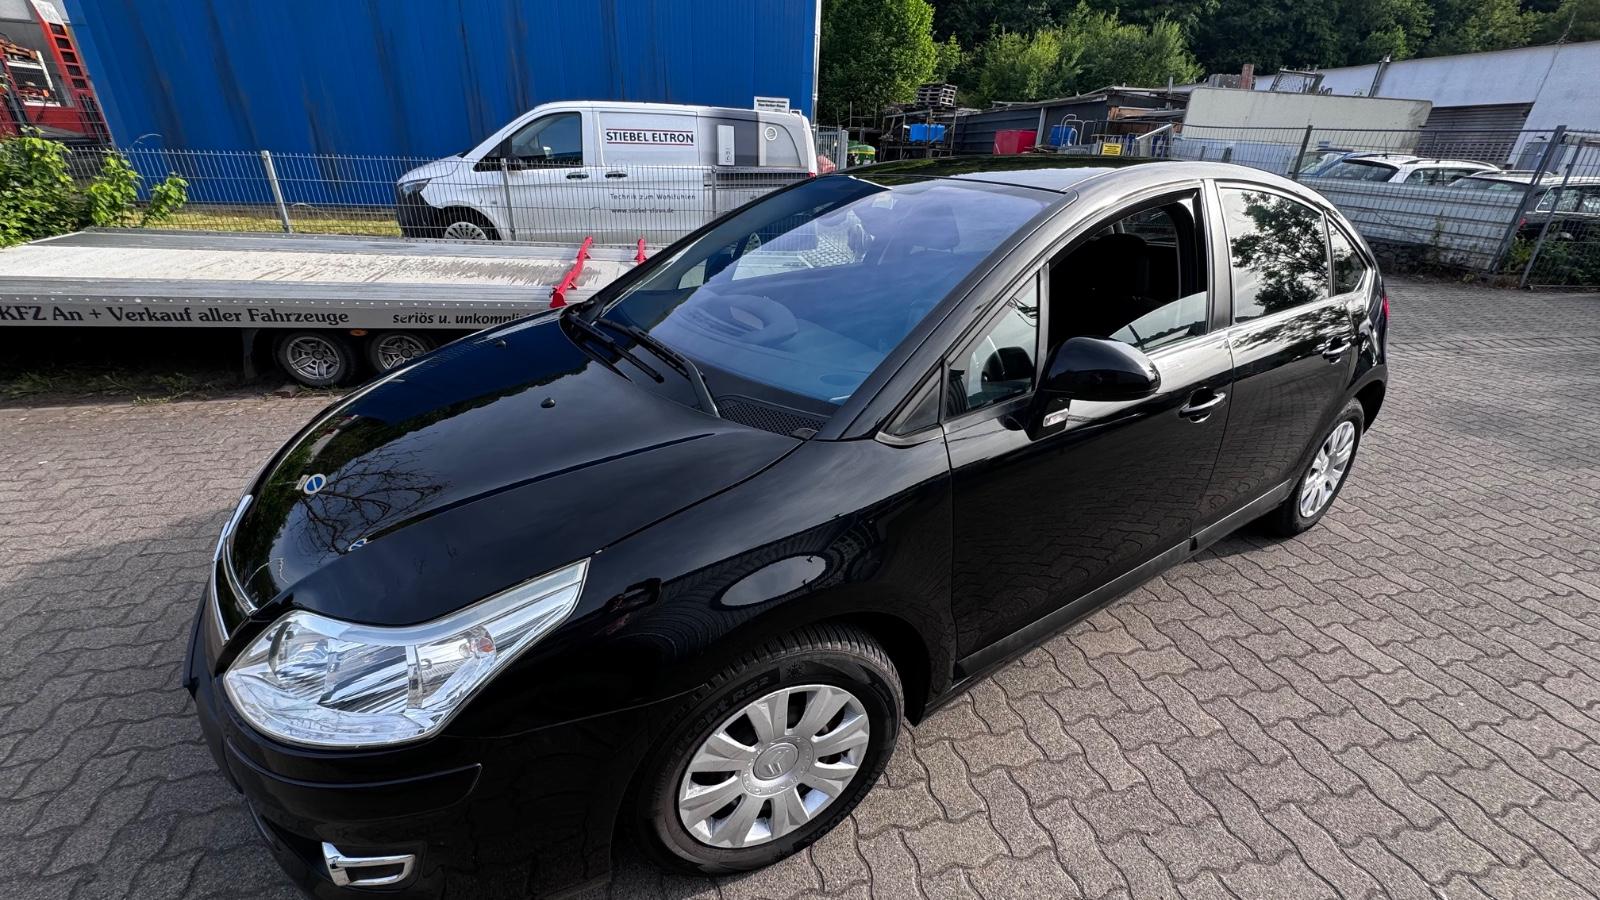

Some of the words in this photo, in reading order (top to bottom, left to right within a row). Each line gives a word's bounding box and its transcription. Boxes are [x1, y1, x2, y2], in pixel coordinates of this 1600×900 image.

[606, 131, 649, 142] STIEBEL
[652, 133, 694, 143] ELTRON
[0, 305, 47, 321] KFZ
[53, 306, 84, 321] An
[89, 308, 102, 319] +
[106, 306, 192, 322] Verkauf
[199, 307, 242, 322] aller
[247, 308, 349, 326] Fahrzeuge
[393, 312, 434, 324] seriös
[438, 315, 451, 324] u.
[455, 312, 530, 324] unkompli
